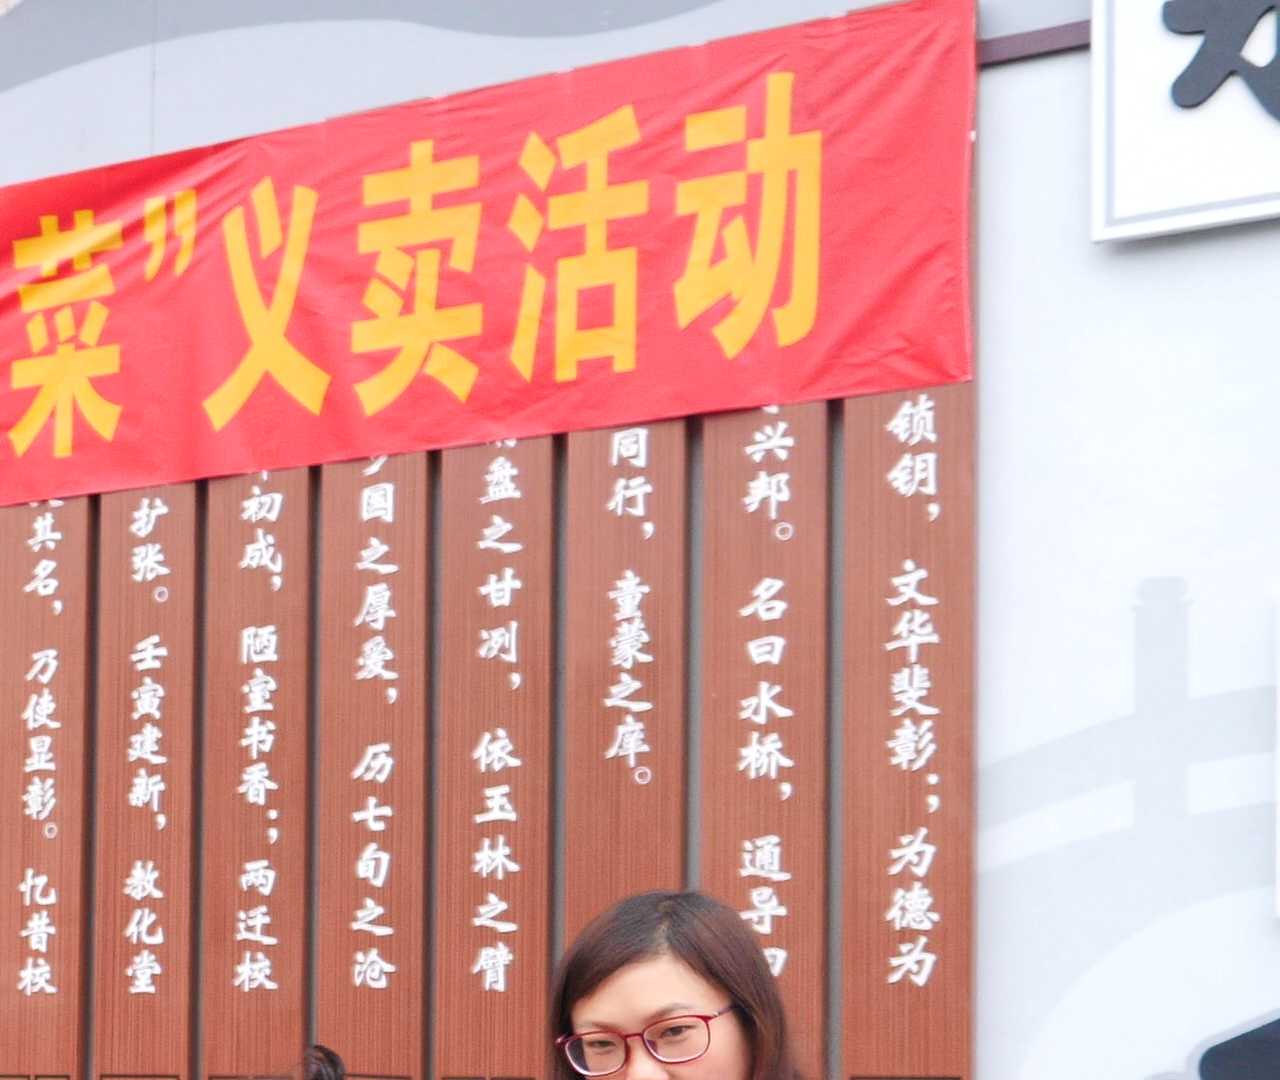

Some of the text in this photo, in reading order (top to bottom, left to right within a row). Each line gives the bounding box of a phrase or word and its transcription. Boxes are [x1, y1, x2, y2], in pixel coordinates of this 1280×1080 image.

[17, 499, 64, 997] 其名，乃使显彰。忆昔校
[234, 470, 284, 992] 初成，陋室书香；两迁校
[472, 437, 524, 993] 盘之甘冽，依玉林之臂
[739, 405, 796, 977] 兴邦。名曰水桥，通导
